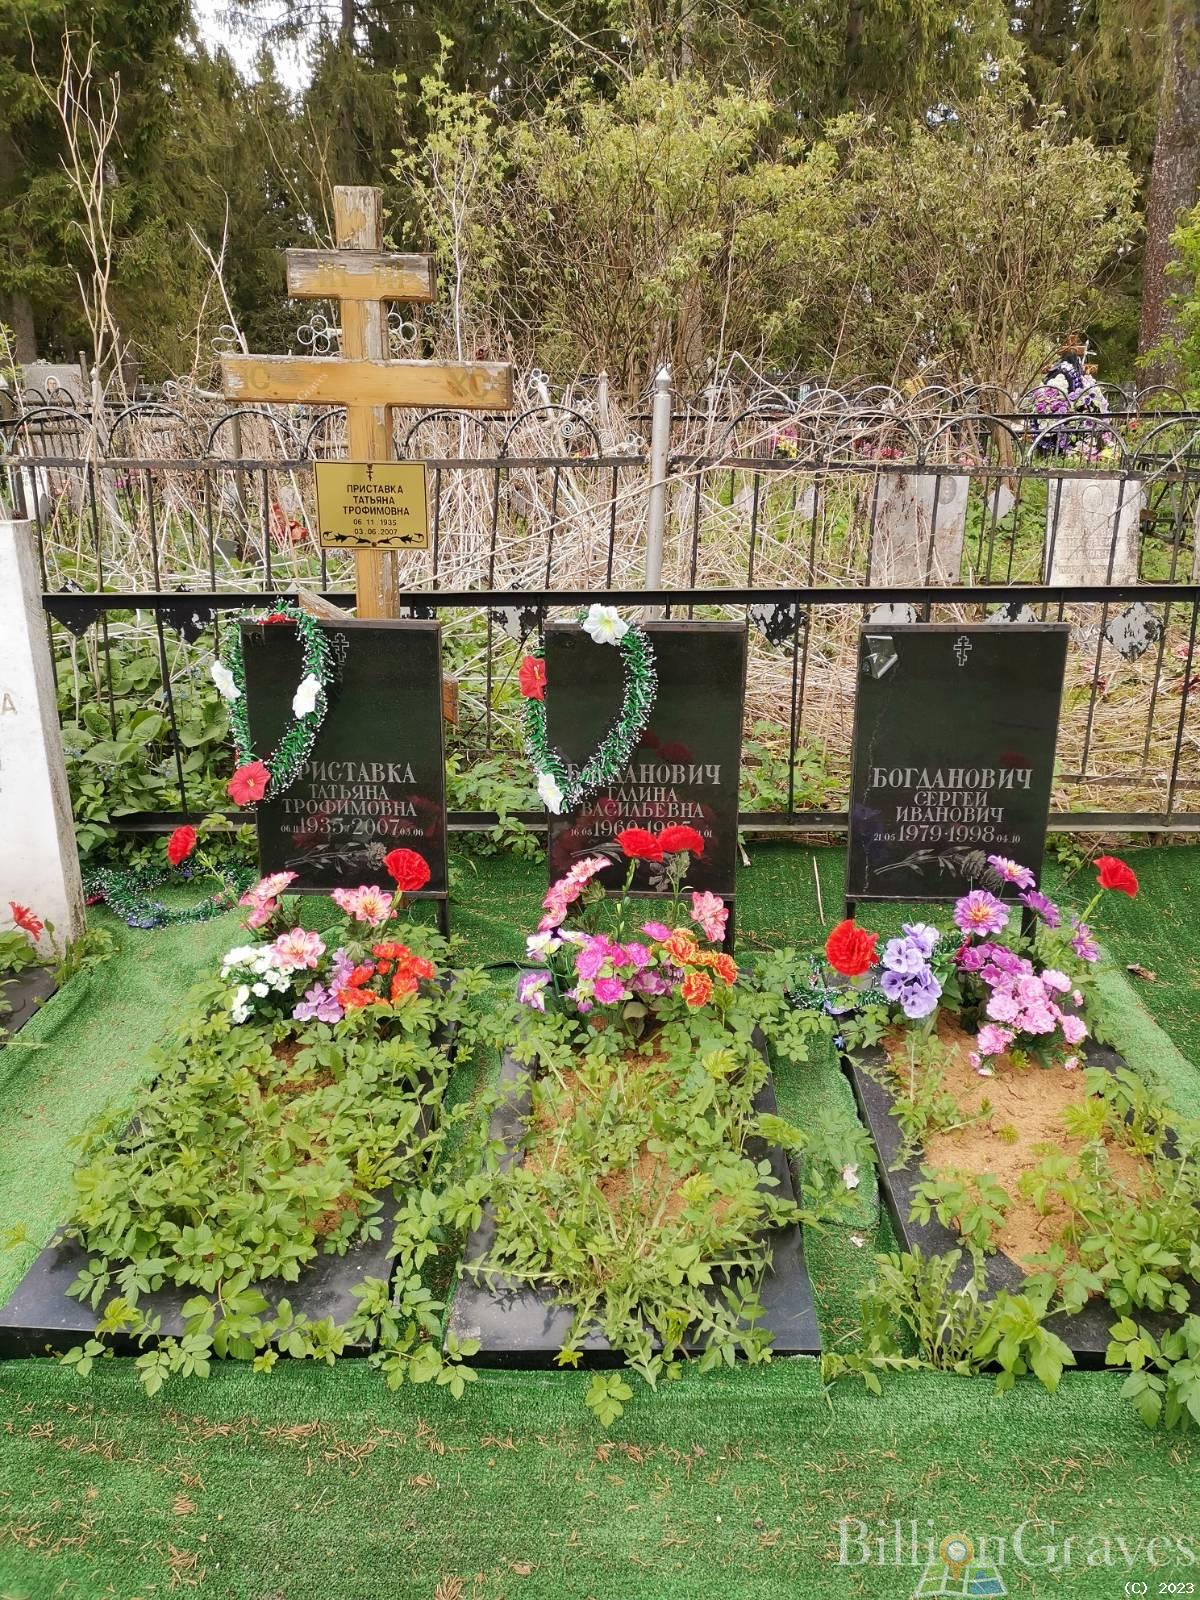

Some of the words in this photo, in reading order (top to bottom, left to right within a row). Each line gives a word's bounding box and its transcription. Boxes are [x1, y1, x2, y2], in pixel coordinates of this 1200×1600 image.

[346, 484, 404, 494] ПРИСТАВКА
[352, 495, 395, 505] ТАТЬЯНА
[342, 505, 410, 516] ТРОФИМОВНА
[297, 761, 417, 783] РИСТАВКА
[871, 767, 1034, 789] БОГДАНОВИЧ
[308, 783, 389, 800] ТАТЬЯНА
[608, 786, 678, 802] ГАЛИНА
[914, 789, 988, 806] СЕРГЕЙ
[282, 798, 418, 817] ТРОФИМОВНА
[582, 801, 705, 818] ВАСИЛЬЕВНА
[896, 806, 1005, 823] ИВАНОВИЧ
